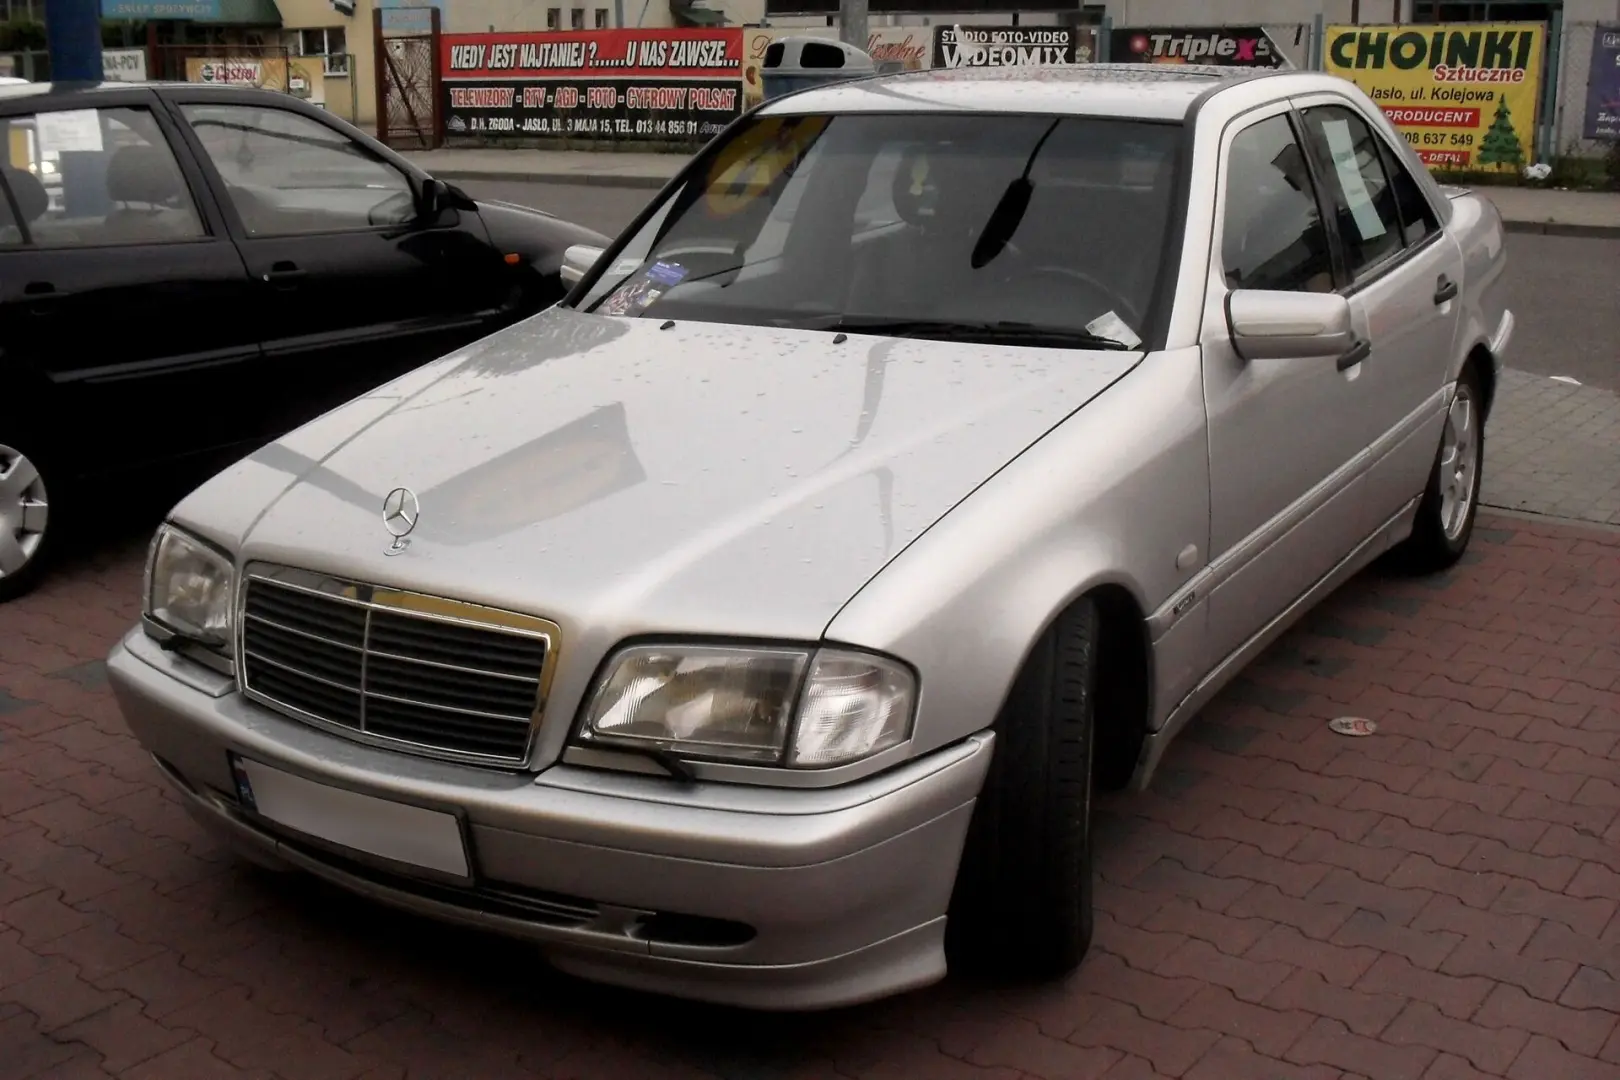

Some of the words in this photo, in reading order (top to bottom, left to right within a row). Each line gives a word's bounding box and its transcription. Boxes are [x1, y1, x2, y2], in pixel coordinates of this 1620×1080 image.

[941, 30, 988, 43] STDIO
[991, 31, 1069, 44] FOTO-VIDEO
[450, 45, 485, 69] KIEDY
[487, 45, 518, 69] JEST
[519, 42, 585, 69] NAJTANIEJ
[639, 40, 667, 68] NAS
[942, 44, 1069, 67] VDEOMIX
[1330, 31, 1534, 70] CHOINKI
[103, 54, 138, 70] NA-PCV
[215, 64, 257, 81] Castrol
[1434, 65, 1525, 83] Sztuczne
[450, 87, 514, 108] TELEWIZORY
[523, 87, 547, 108] RTV
[554, 87, 579, 109] AGD
[587, 87, 616, 109] FOTO
[627, 87, 687, 110] CYFROWY
[688, 87, 737, 111] POLSAT
[1410, 88, 1426, 100] ul.
[1431, 87, 1494, 104] Kolejowa
[1385, 109, 1473, 123] PRODUCENT
[488, 118, 515, 131] ZGODA
[567, 119, 573, 132] 3
[599, 119, 613, 134] 15,
[615, 119, 634, 133] TEL.
[636, 120, 652, 133] 013
[655, 121, 667, 133] 44
[668, 121, 685, 134] 856
[687, 121, 698, 134] 01
[1400, 132, 1420, 145] 08
[1423, 133, 1446, 145] 637
[1450, 134, 1474, 146] 549
